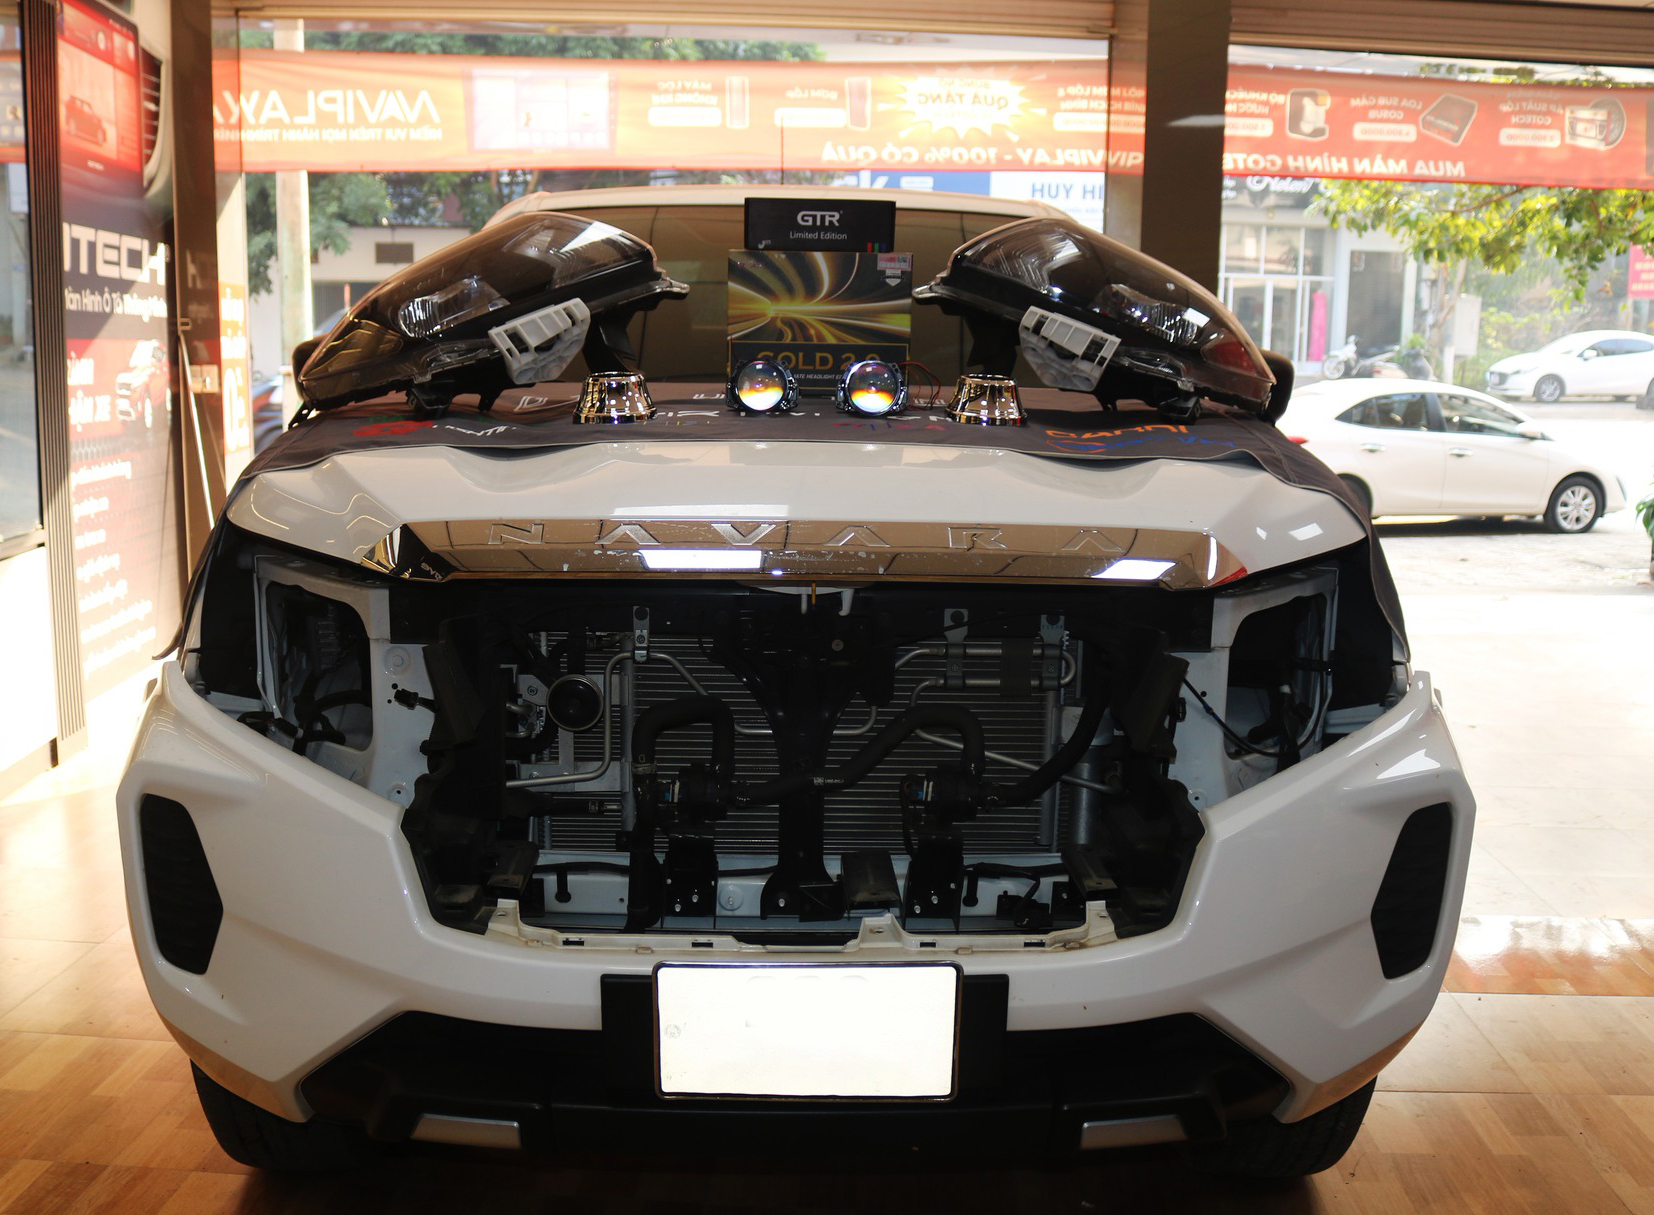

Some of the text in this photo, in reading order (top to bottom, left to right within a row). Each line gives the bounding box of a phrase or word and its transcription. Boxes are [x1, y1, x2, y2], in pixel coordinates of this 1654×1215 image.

[1031, 183, 1074, 200] HUY
[797, 211, 840, 226] GTR
[789, 230, 848, 240] Limited Edition
[488, 523, 1123, 551] NAVARA
